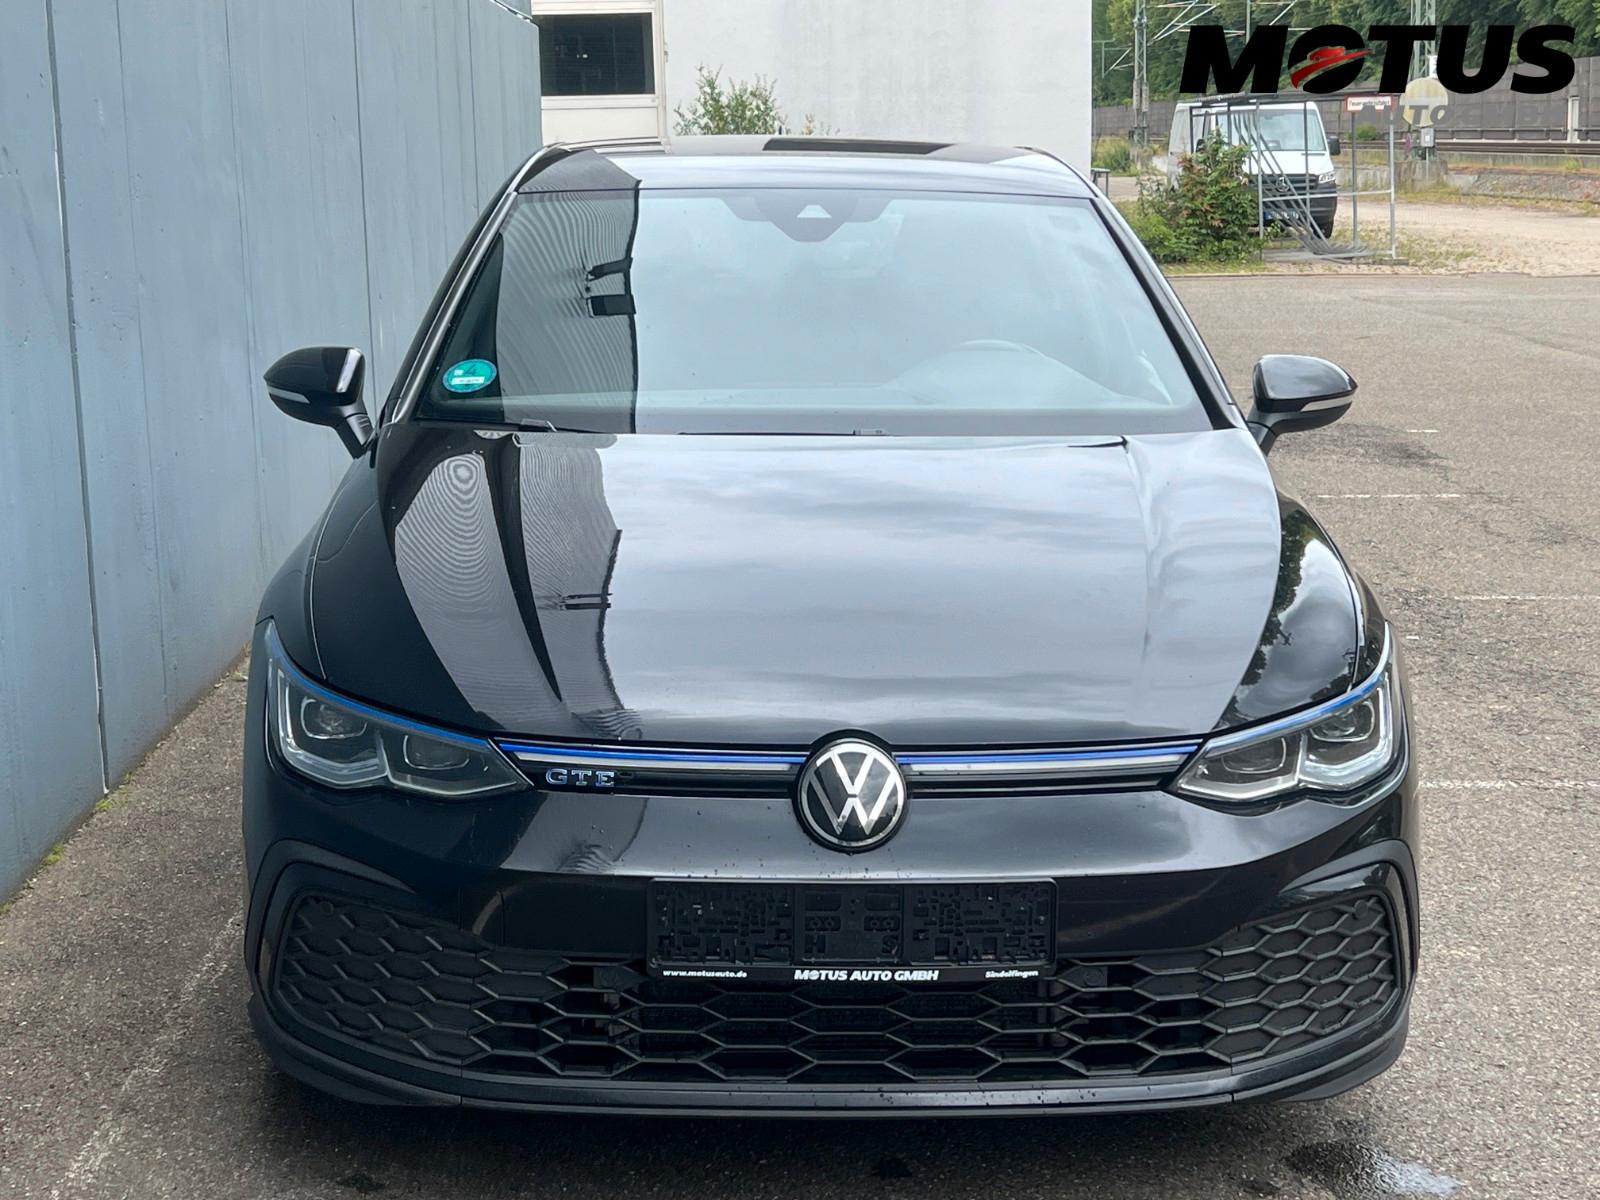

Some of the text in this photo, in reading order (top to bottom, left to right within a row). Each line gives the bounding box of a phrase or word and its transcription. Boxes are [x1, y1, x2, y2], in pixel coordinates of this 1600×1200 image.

[545, 768, 616, 788] GTE
[662, 969, 748, 978] www.motusauto.de
[793, 969, 940, 981] MOTUS AUTO GMBH
[985, 969, 1039, 979] Sindelfingen
